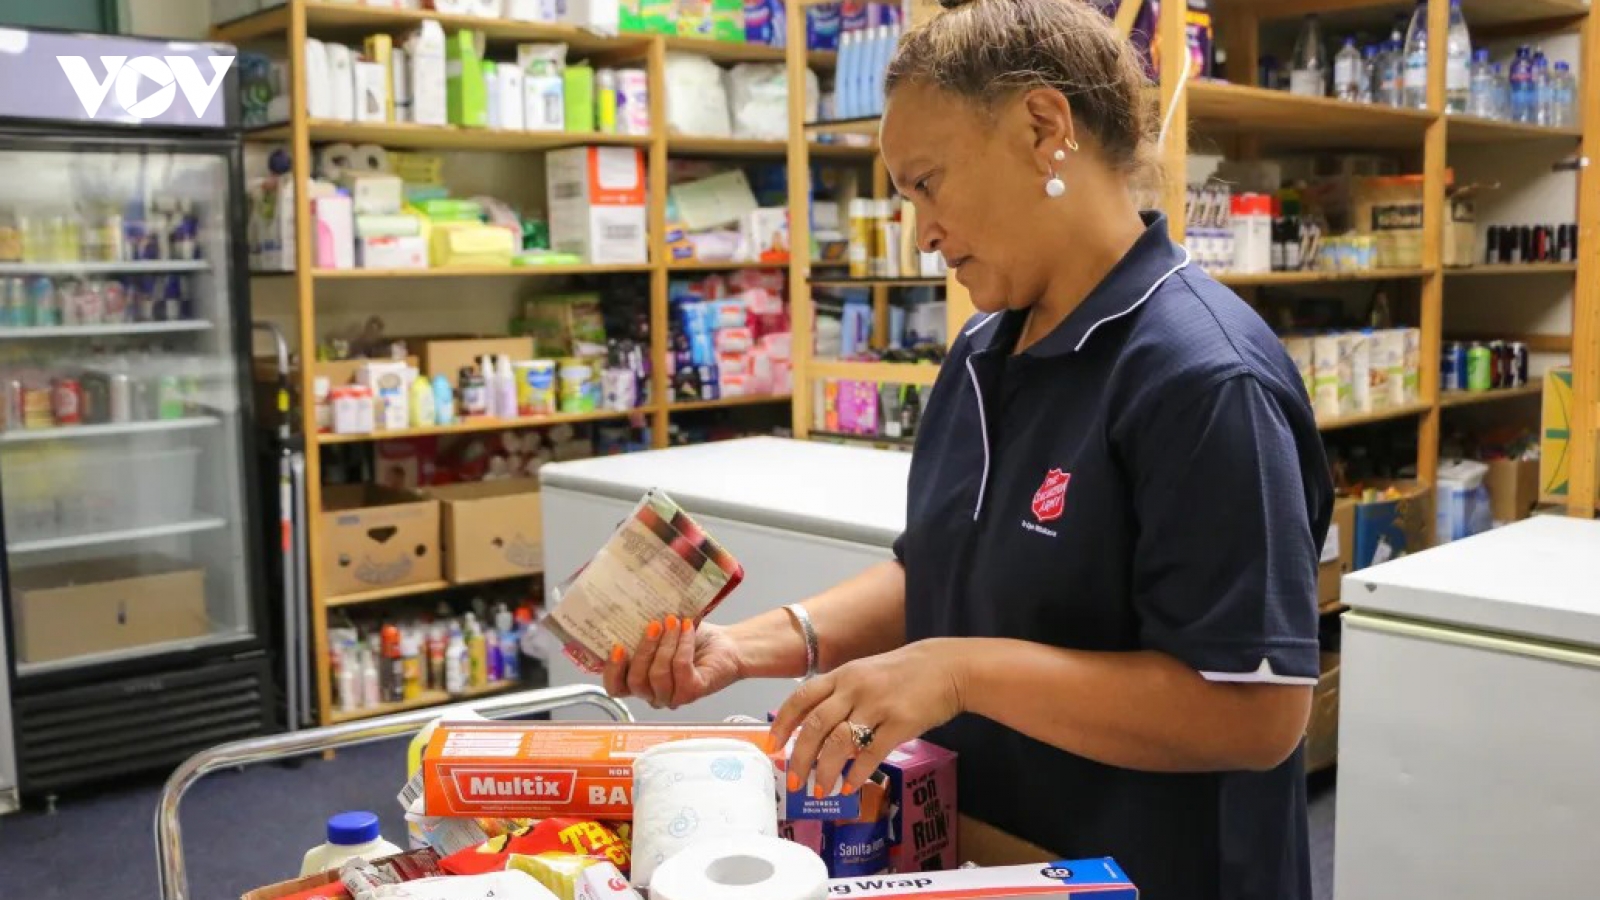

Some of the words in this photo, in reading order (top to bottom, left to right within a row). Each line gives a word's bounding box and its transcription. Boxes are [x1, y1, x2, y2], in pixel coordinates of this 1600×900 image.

[470, 775, 560, 796] Multix
[588, 785, 633, 805] BA
[828, 883, 852, 895] g
[856, 877, 933, 890] Wrap
